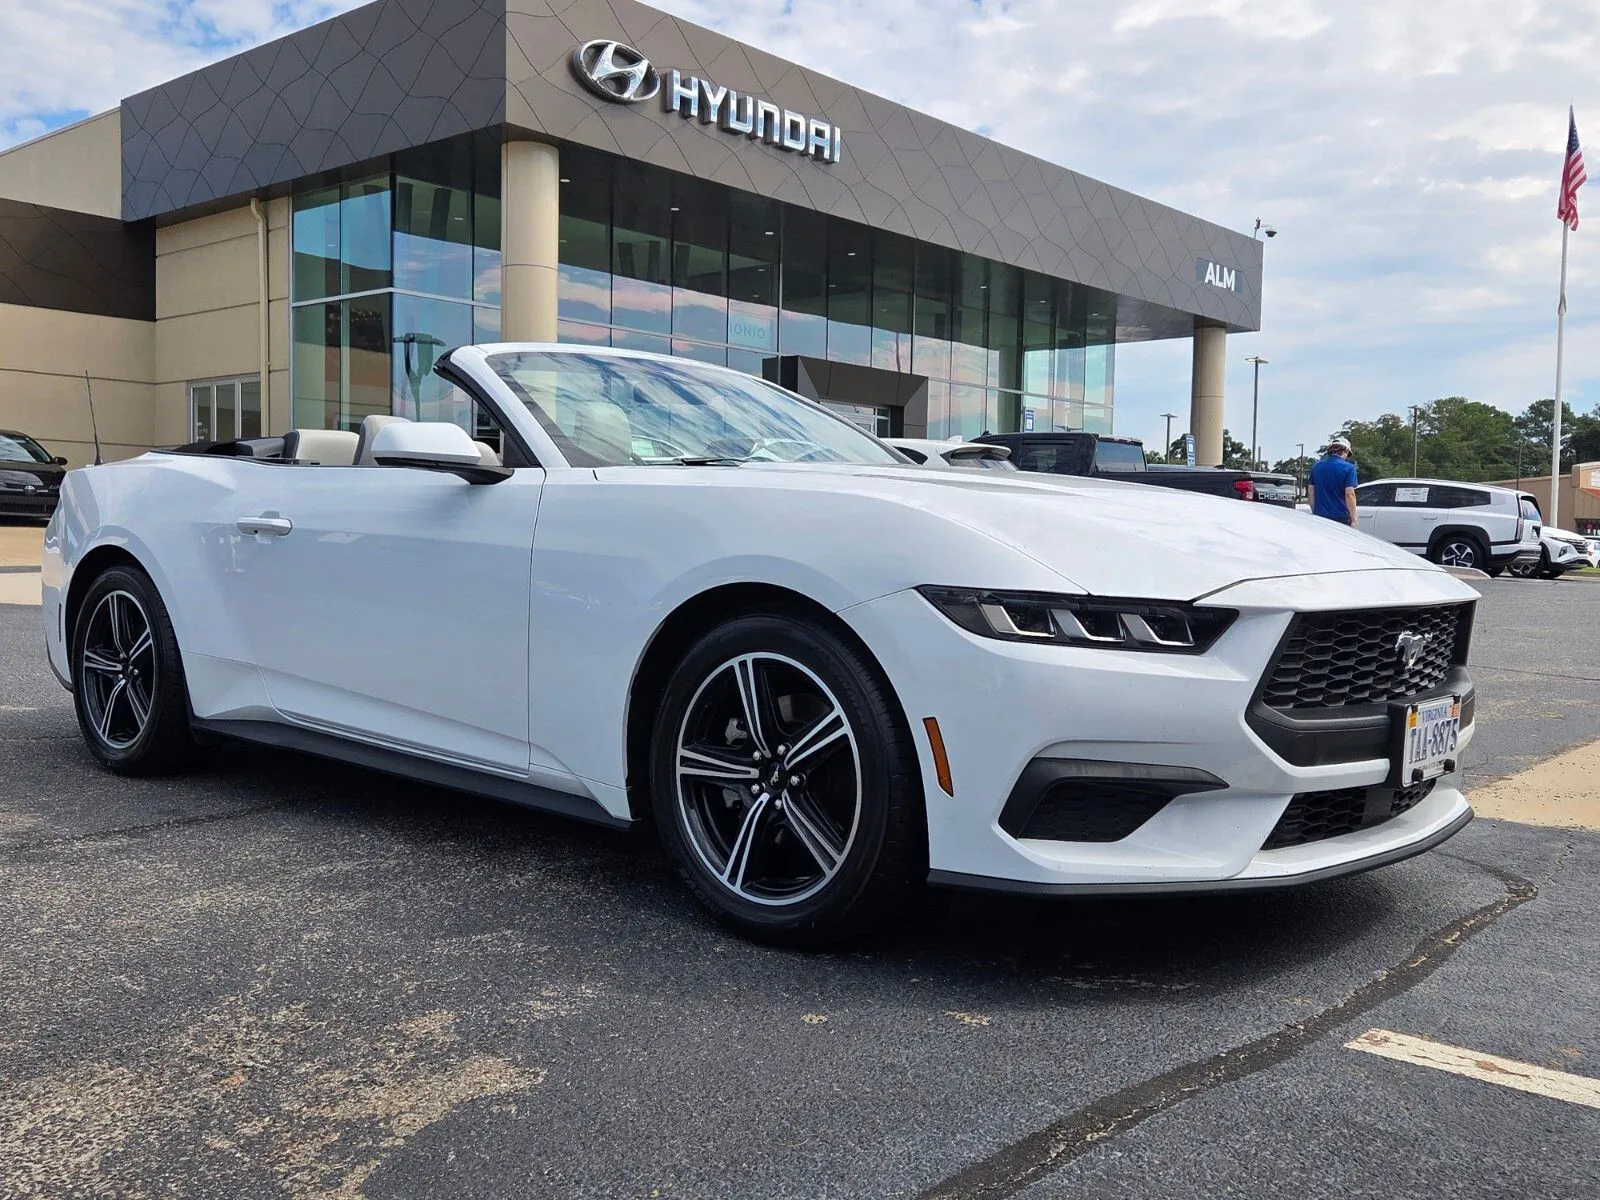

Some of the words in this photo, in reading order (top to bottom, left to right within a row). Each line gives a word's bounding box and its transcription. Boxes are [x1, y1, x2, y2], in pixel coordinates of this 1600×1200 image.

[667, 69, 840, 163] HYUNDAI
[1205, 262, 1235, 291] ALM
[1408, 717, 1459, 764] TAA-8875
